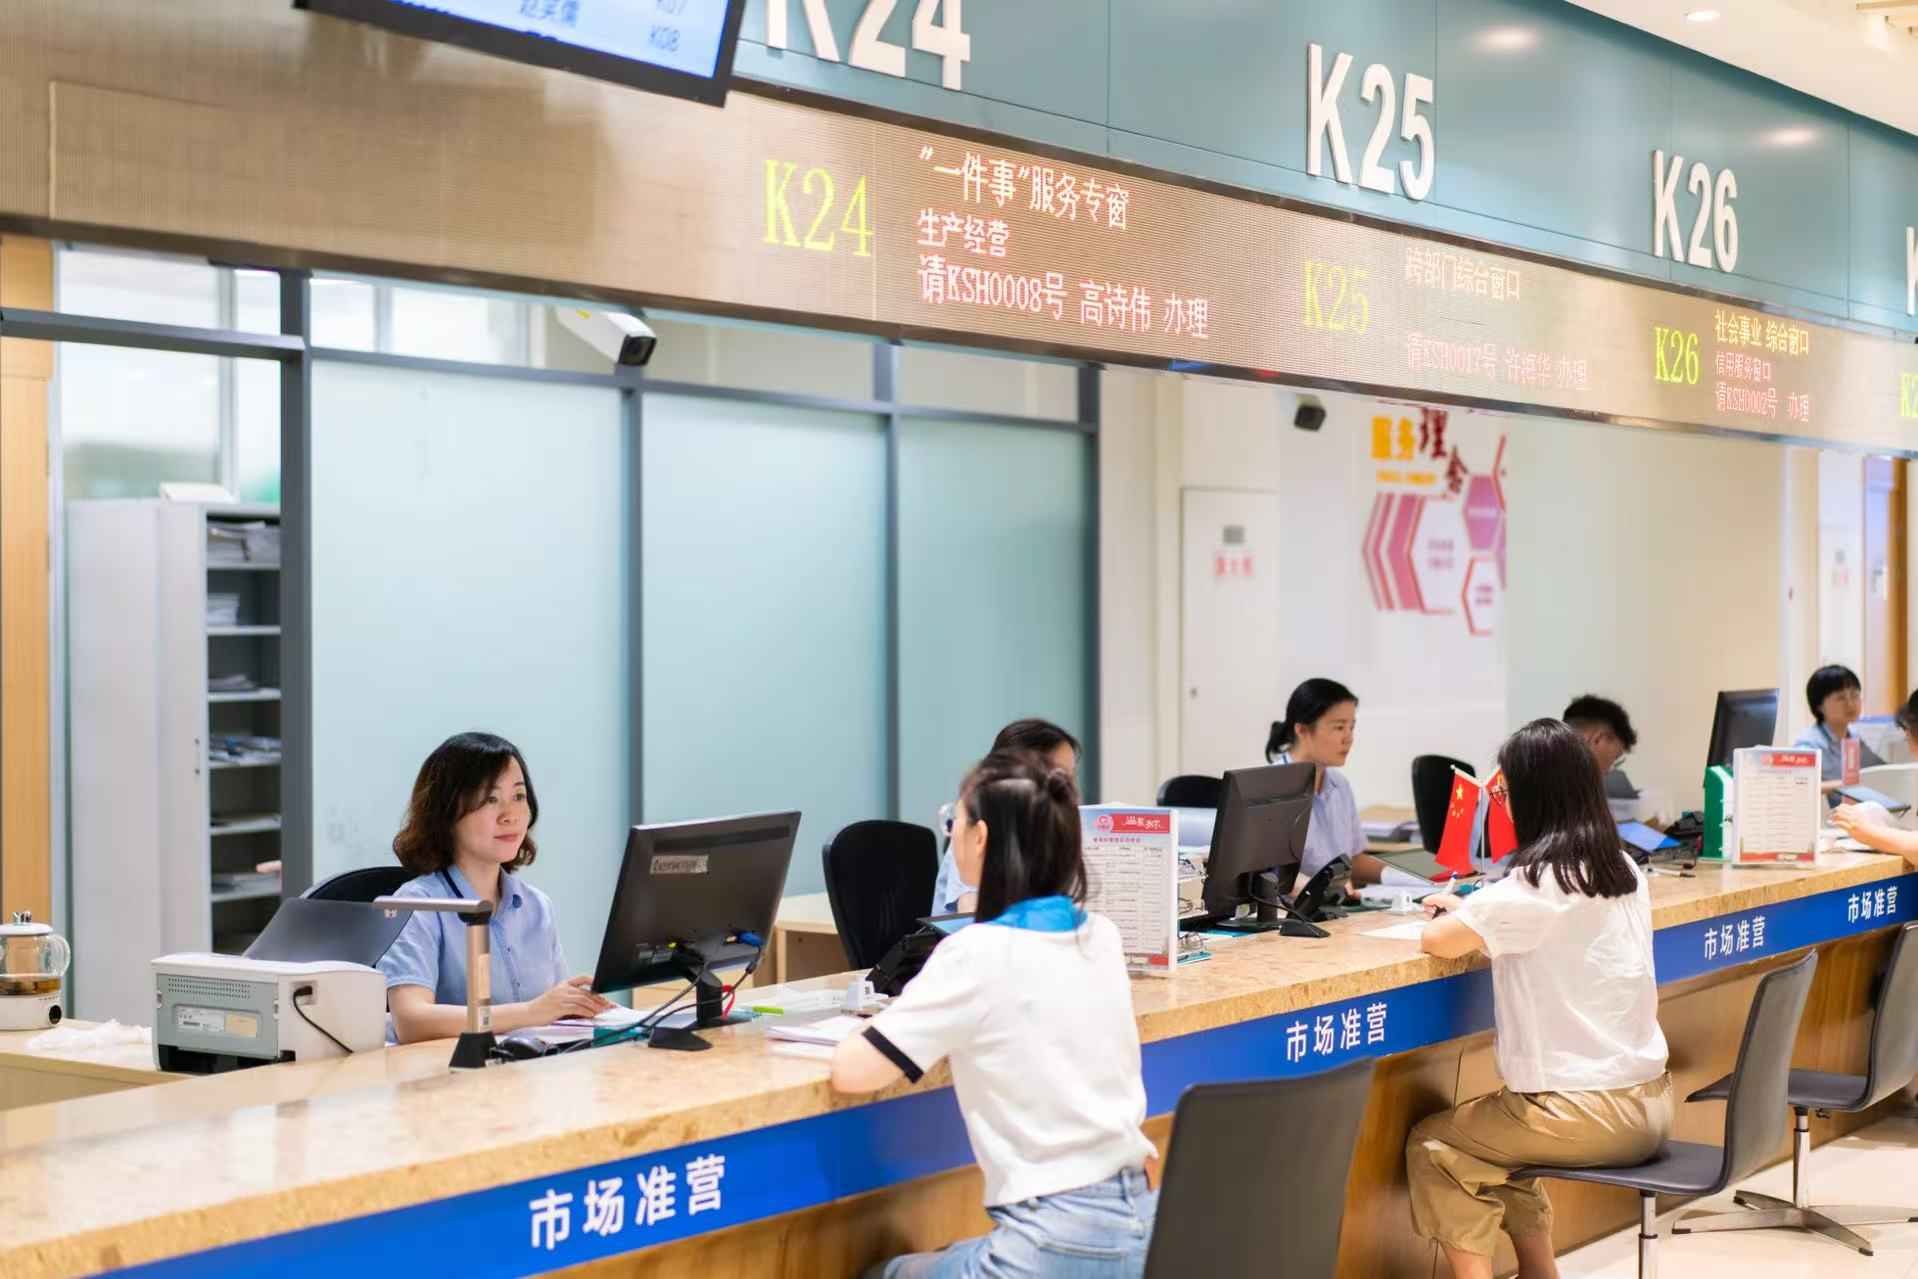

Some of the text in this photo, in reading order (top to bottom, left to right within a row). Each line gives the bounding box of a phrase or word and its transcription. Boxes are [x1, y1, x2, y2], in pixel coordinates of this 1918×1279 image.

[1306, 42, 1434, 200] K25
[763, 159, 874, 257] K24
[917, 208, 1010, 257] 生产经营
[1653, 149, 1738, 273] K26
[917, 255, 1209, 339] 请KSH0008号 高诗伟 办理
[1303, 259, 1370, 334] K25
[1654, 326, 1699, 385] K26
[1714, 309, 1809, 356] 社会事业 综合窗口
[1557, 355, 1588, 391] 办理
[1714, 351, 1772, 382] 信用服务窗口
[1787, 391, 1809, 423] 办理
[1847, 885, 1898, 924] 市场准营
[1704, 914, 1766, 961] 市场准营
[1286, 1001, 1388, 1063] 市场准营
[528, 1153, 726, 1250] 市场准营
